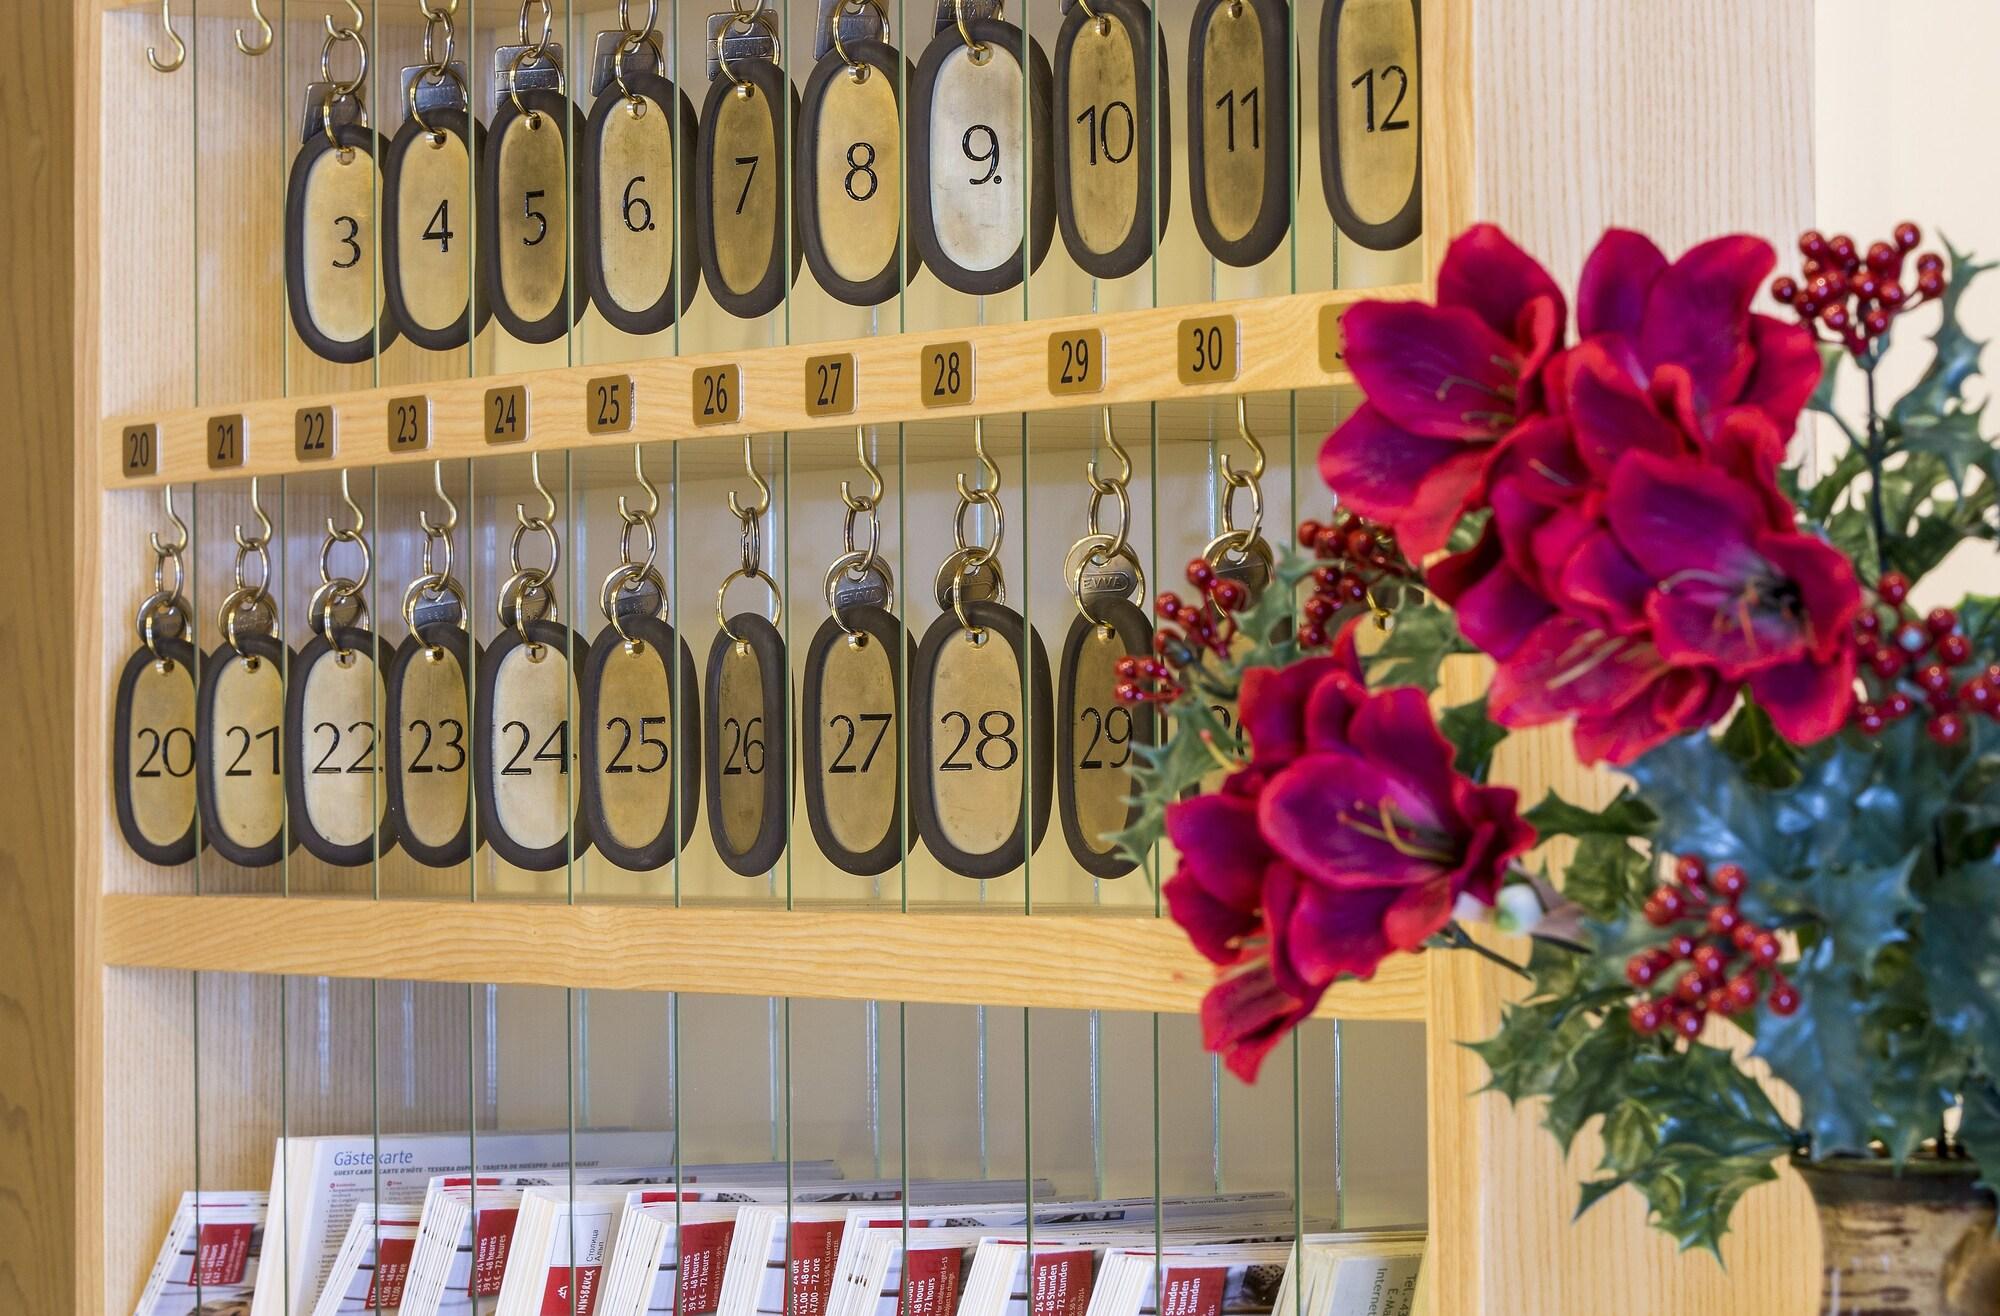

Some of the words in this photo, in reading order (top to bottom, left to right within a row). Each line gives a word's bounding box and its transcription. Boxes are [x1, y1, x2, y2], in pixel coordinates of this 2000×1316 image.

[1351, 65, 1410, 133] 12
[1076, 100, 1135, 166] 10
[1215, 86, 1260, 152] 11
[734, 156, 759, 214] 7
[844, 142, 878, 202] 8
[422, 199, 454, 253] 4
[523, 190, 547, 246] 5
[332, 216, 361, 268] 3
[1060, 339, 1089, 384] 29
[1191, 326, 1222, 372] 30
[817, 362, 842, 405] 27
[934, 352, 961, 396] 28
[597, 385, 620, 424] 25
[703, 373, 728, 414] 26
[303, 413, 326, 450] 22
[396, 406, 418, 443] 23
[493, 395, 517, 433] 24
[129, 433, 150, 467] 20
[216, 424, 236, 459] 21
[1083, 576, 1121, 590] EVVA
[136, 727, 197, 779] 20
[225, 725, 281, 777] 21
[312, 721, 383, 774] 22
[408, 718, 466, 773] 23
[605, 716, 667, 775] 25
[723, 717, 766, 775] 26
[828, 713, 893, 774] 27
[939, 710, 1019, 772] 28
[1080, 706, 1133, 769] 29
[334, 1150, 413, 1167] Gästekarte
[477, 1237, 488, 1263] heures
[486, 1235, 497, 1261] heures
[496, 1234, 507, 1259] heures
[586, 1229, 599, 1262] Столица
[700, 1250, 710, 1276] heures
[683, 1255, 691, 1281] heures
[691, 1252, 700, 1279] heures
[700, 1277, 708, 1287] 72
[801, 1274, 810, 1285] 48
[803, 1259, 811, 1273] ore
[811, 1274, 820, 1284] 72
[813, 1258, 821, 1272] ore
[1047, 1264, 1058, 1300] Stunden
[1058, 1261, 1068, 1297] Stunden
[577, 1270, 595, 1314] INNSBRUCK
[690, 1279, 698, 1289] 48
[914, 1280, 925, 1303] hours
[924, 1277, 935, 1301] hours
[1036, 1265, 1047, 1301] Stunden
[1165, 1281, 1179, 1315] Stunden
[1176, 1280, 1190, 1315] Stunden
[1188, 1278, 1200, 1313] Stunden
[1367, 1268, 1388, 1316] Internet
[688, 1302, 696, 1312] 39
[698, 1300, 706, 1310] 45
[800, 1292, 809, 1315] 41,00
[810, 1292, 819, 1314] 47,00
[914, 1304, 922, 1313] 48
[924, 1302, 933, 1313] 72
[1035, 1302, 1044, 1312] 24
[1046, 1301, 1055, 1311] 48
[1057, 1299, 1066, 1310] 72
